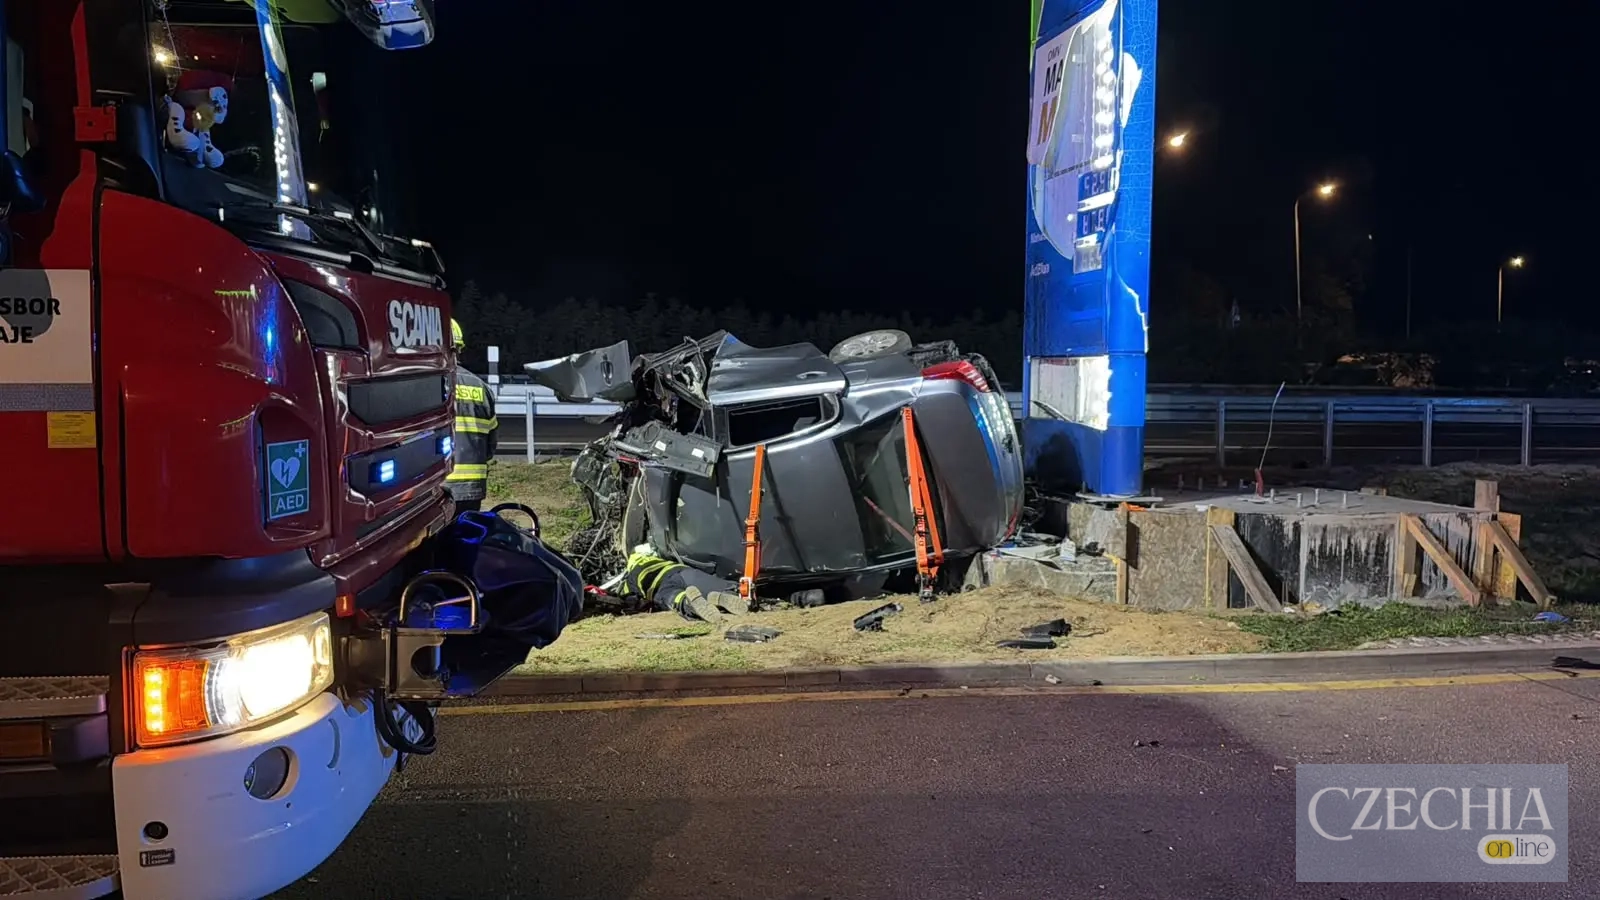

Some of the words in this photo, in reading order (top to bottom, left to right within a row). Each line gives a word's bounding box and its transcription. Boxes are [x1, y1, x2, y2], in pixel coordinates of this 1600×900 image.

[1047, 43, 1063, 62] OMV
[0, 297, 61, 316] SBOR
[389, 299, 443, 347] SCANIA
[275, 494, 305, 513] AED
